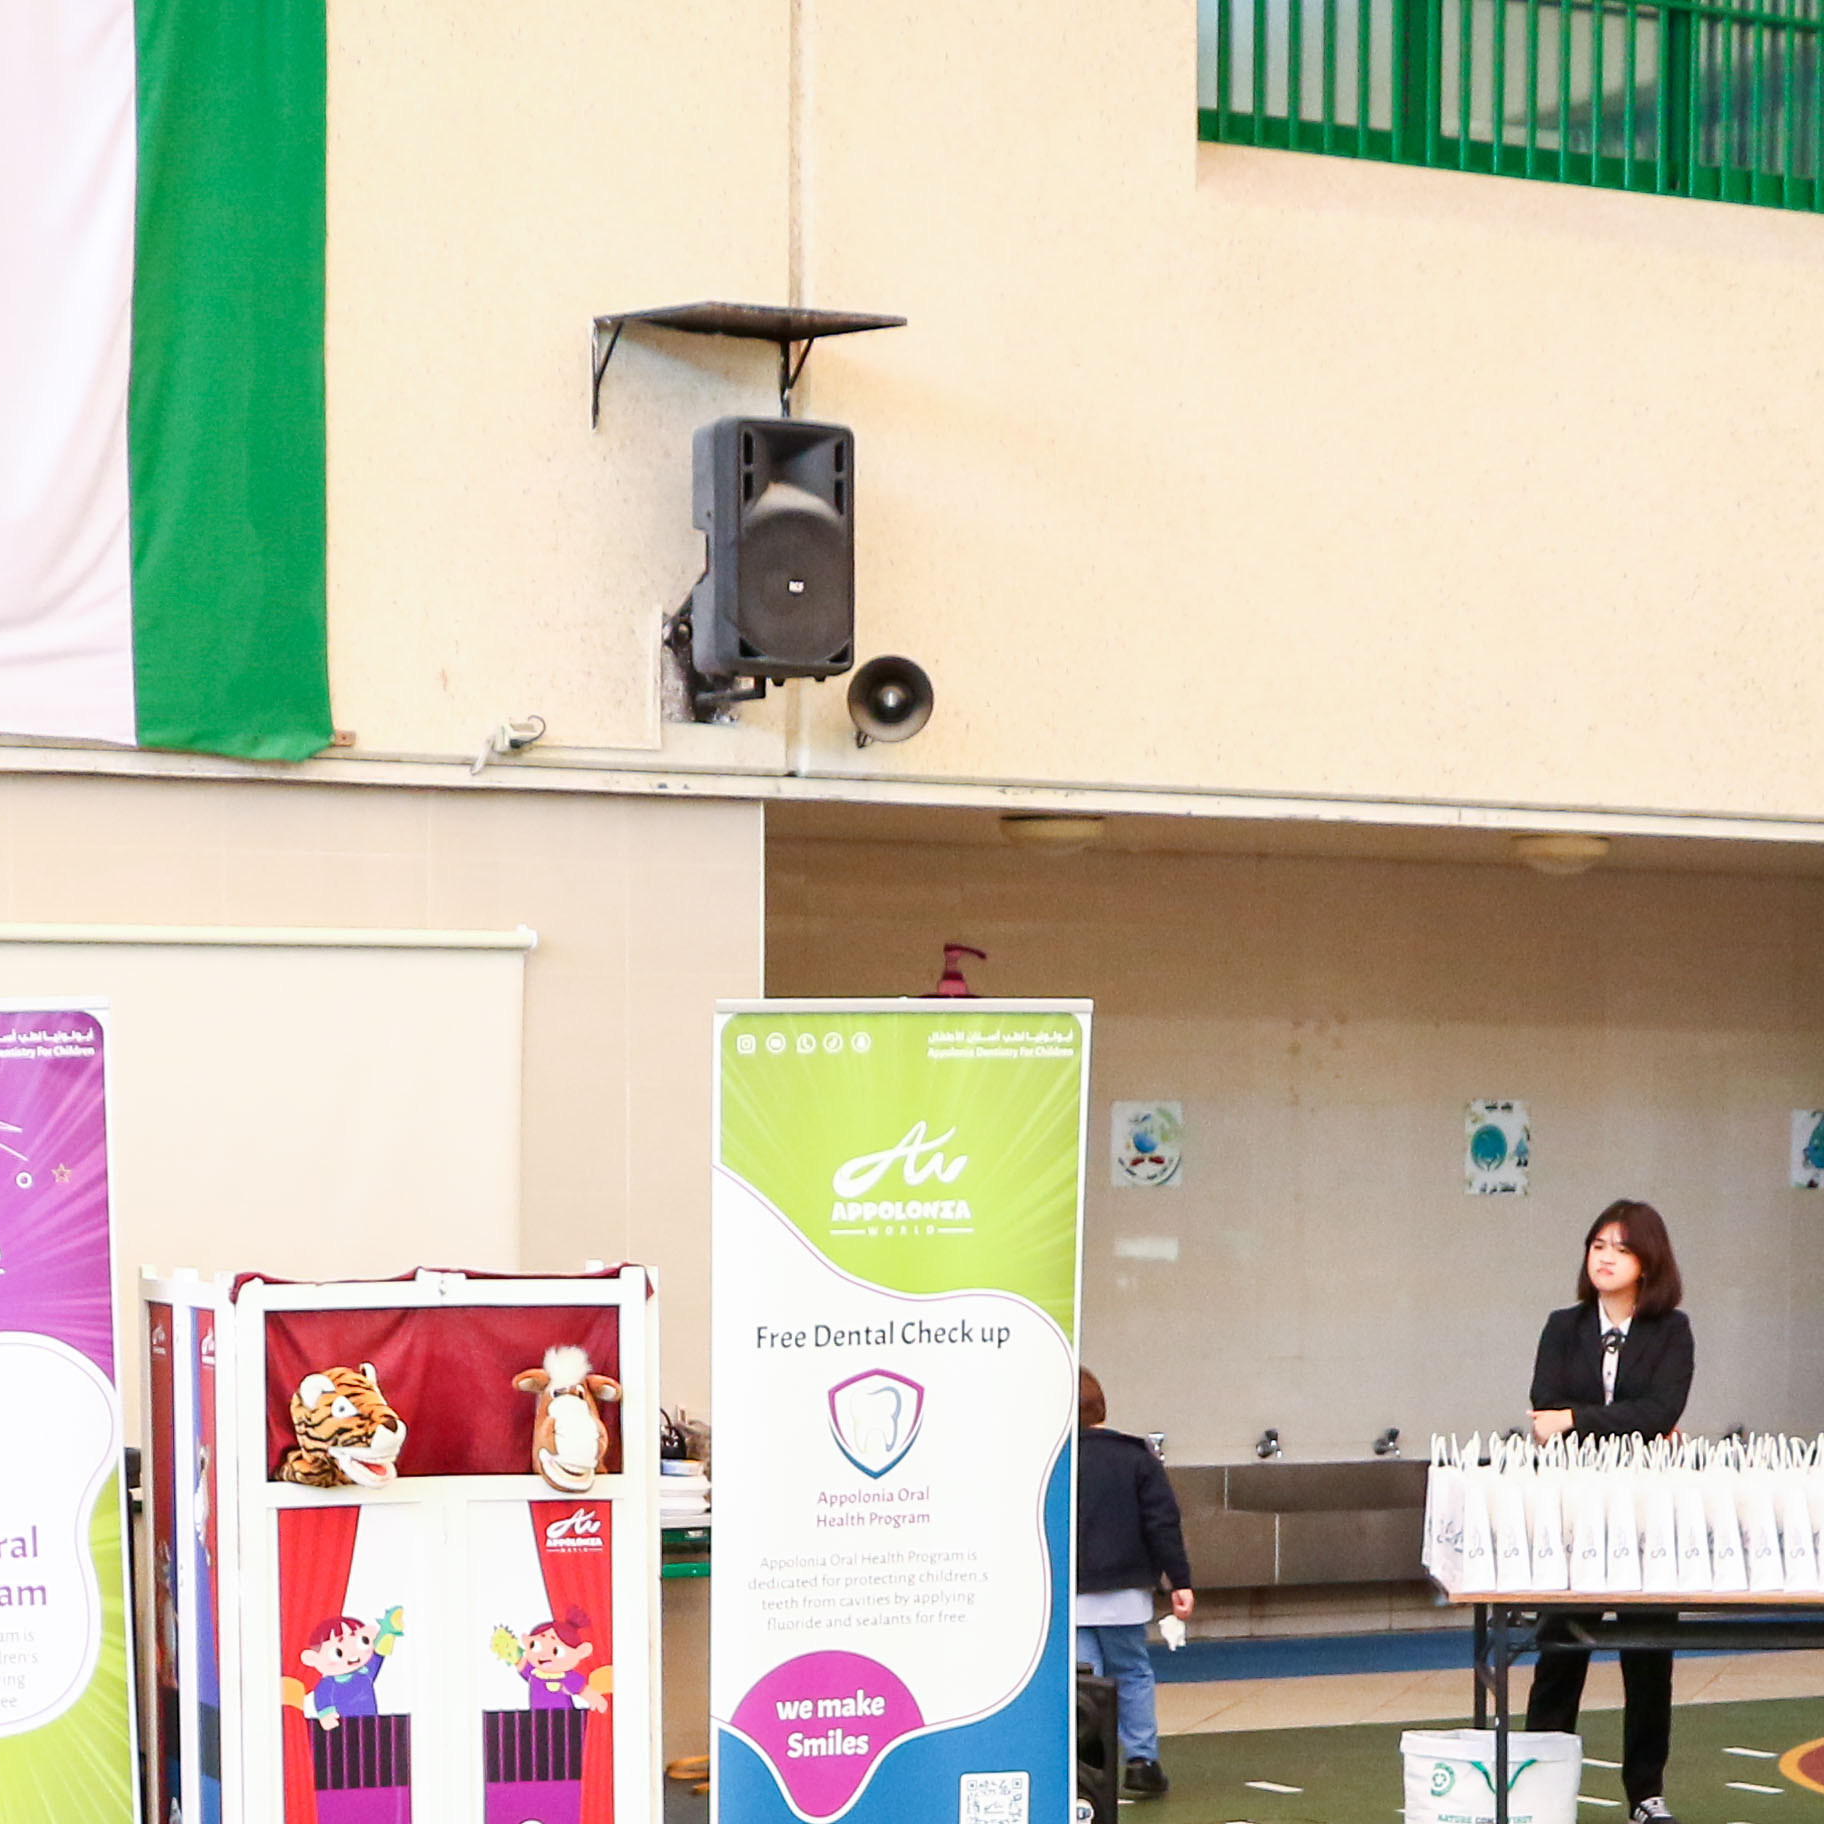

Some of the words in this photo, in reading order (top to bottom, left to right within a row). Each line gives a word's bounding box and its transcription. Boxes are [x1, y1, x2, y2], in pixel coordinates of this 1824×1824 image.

[831, 1200, 972, 1222] APPOLONIA
[756, 1325, 806, 1349] Free
[814, 1320, 894, 1348] Dental
[901, 1319, 974, 1345] Check
[980, 1326, 1011, 1349] up
[817, 1488, 894, 1508] Appolonia
[897, 1486, 930, 1502] Oral
[816, 1512, 865, 1528] Health
[869, 1511, 931, 1529] Program
[760, 1555, 827, 1571] Appolonia
[830, 1553, 858, 1567] Oral
[861, 1551, 905, 1566] Health
[908, 1549, 964, 1566] Program
[967, 1549, 978, 1561] is
[747, 1575, 818, 1591] dedicated
[822, 1573, 841, 1588] for
[844, 1572, 917, 1589] protecting
[761, 1595, 799, 1611] teeth
[802, 1594, 836, 1609] from
[839, 1593, 891, 1607] cavities
[894, 1591, 910, 1606] by
[913, 1589, 975, 1606] applying
[767, 1615, 823, 1632] fluoride
[825, 1612, 852, 1628] and
[855, 1611, 912, 1627] sealants
[915, 1609, 935, 1624] for
[23, 1627, 36, 1643] is
[776, 1699, 813, 1720] we
[817, 1689, 886, 1719] make
[786, 1728, 870, 1758] Smiles
